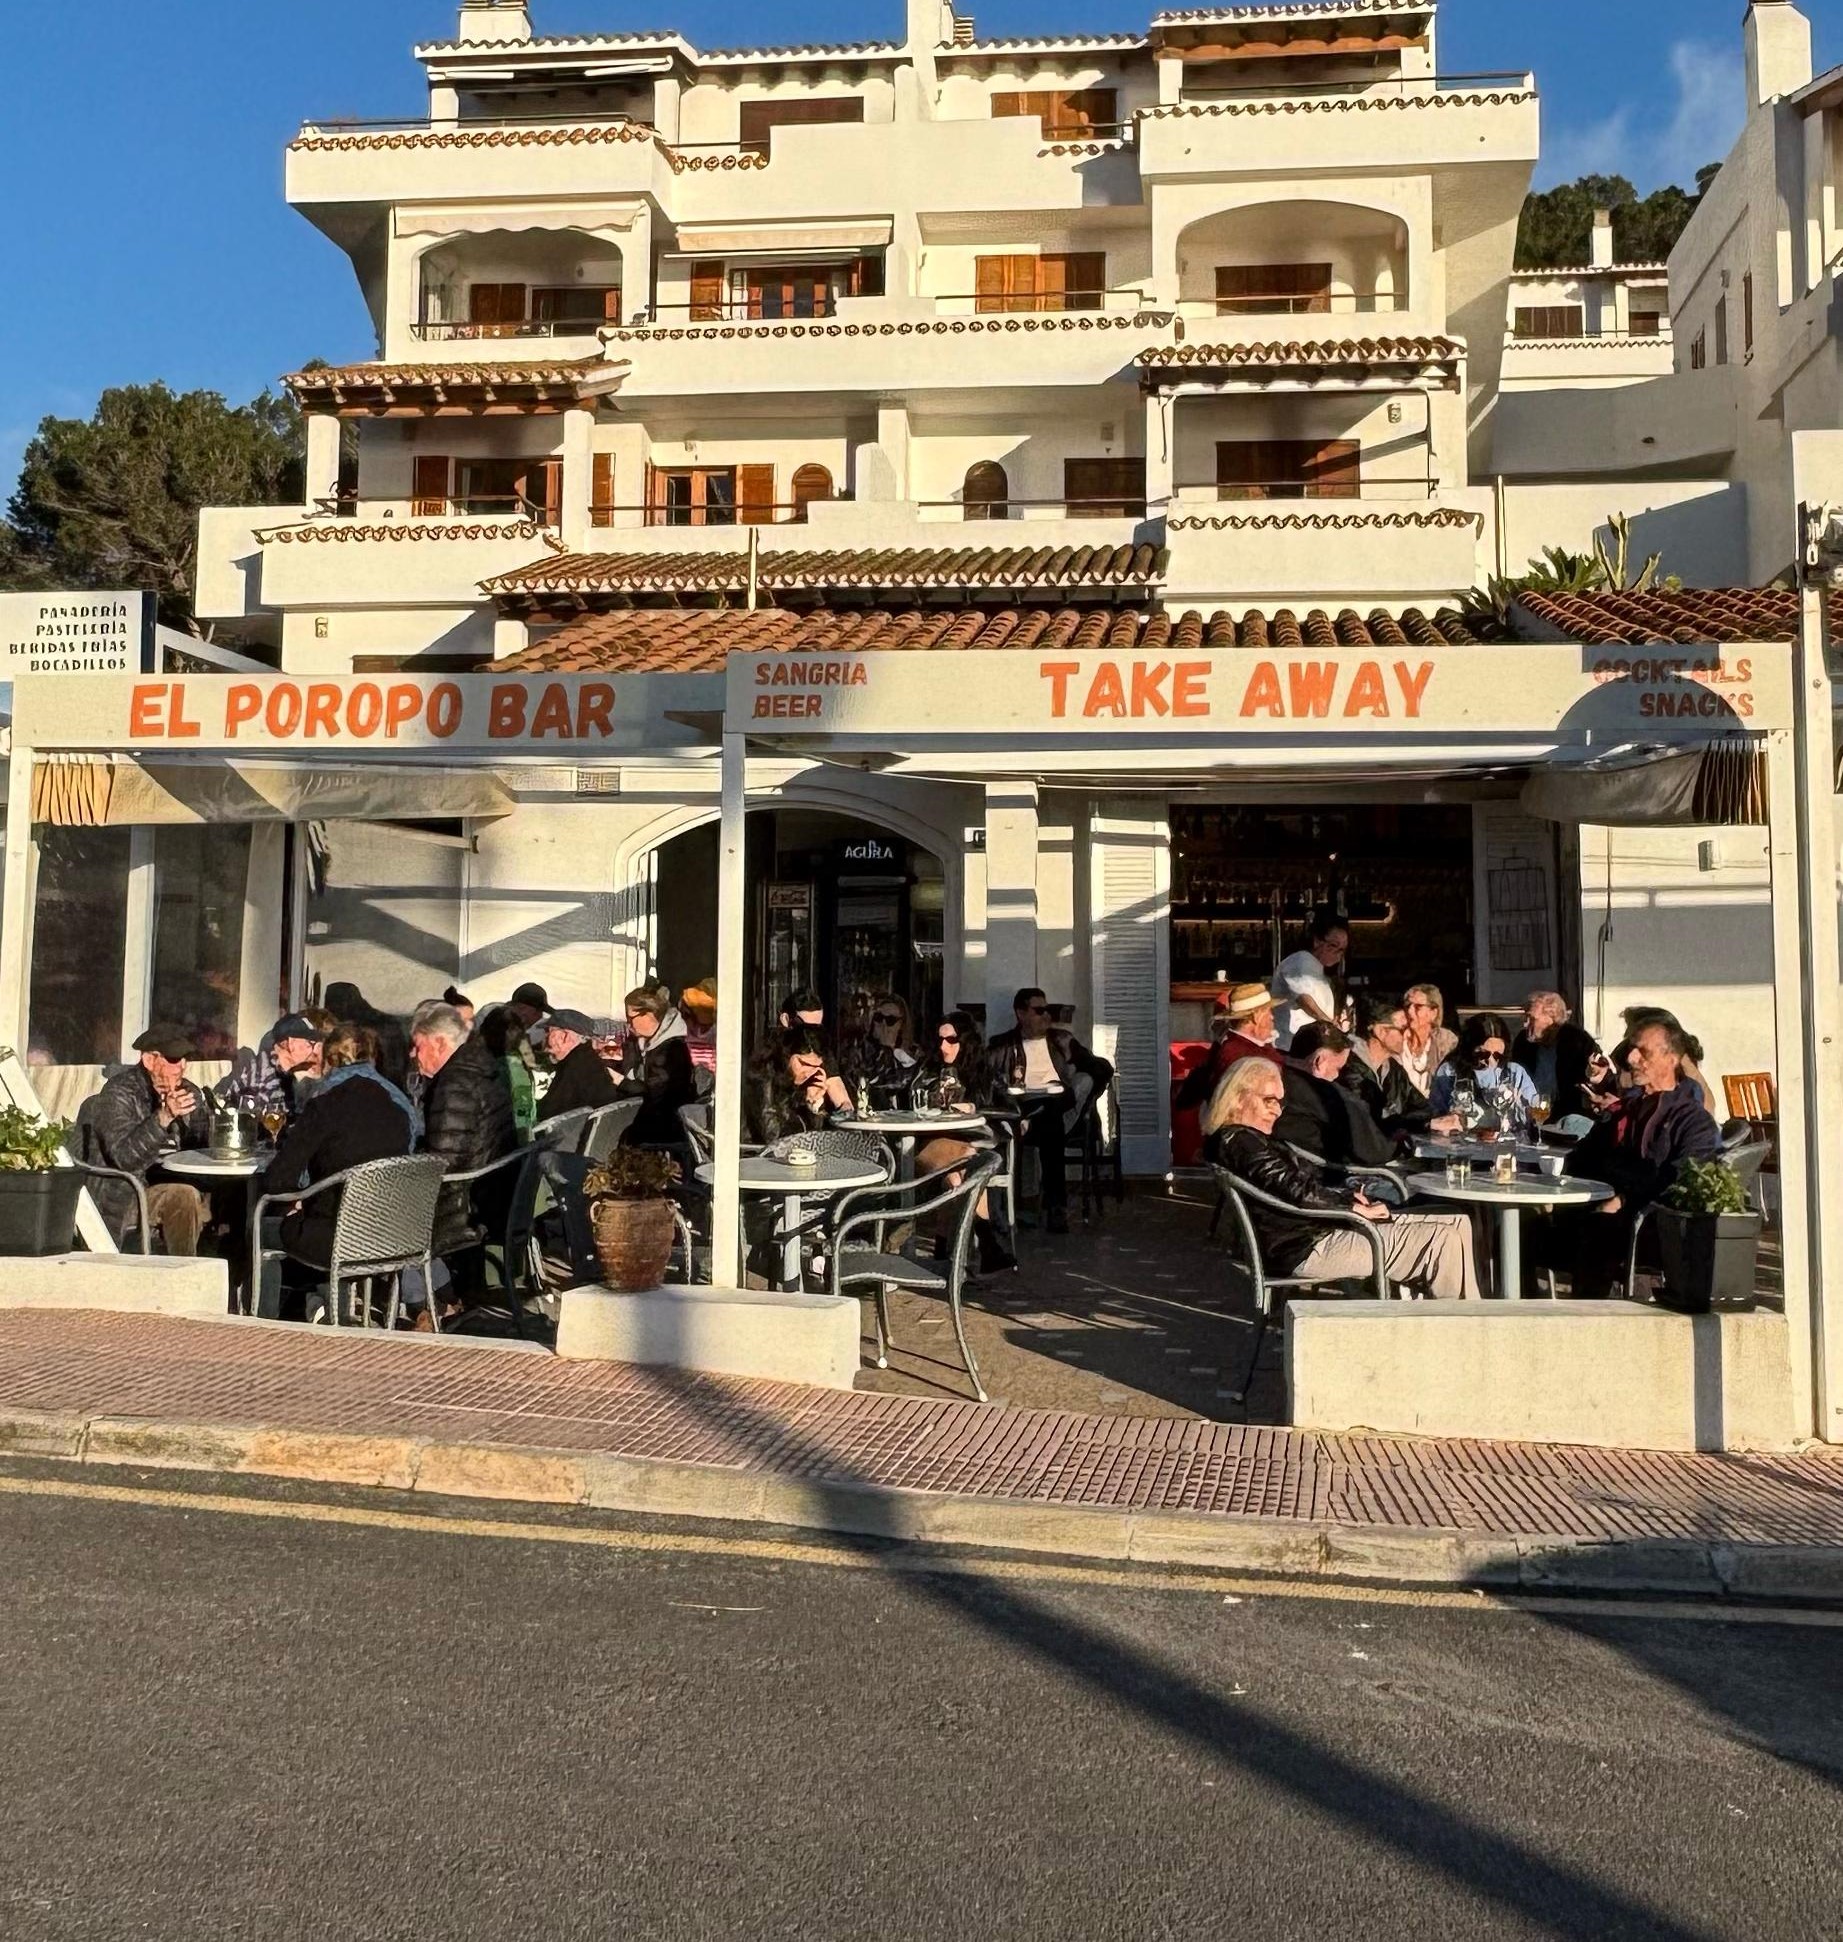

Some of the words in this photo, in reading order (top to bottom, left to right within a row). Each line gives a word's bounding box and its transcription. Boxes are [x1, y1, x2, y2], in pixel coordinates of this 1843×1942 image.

[9, 642, 75, 654] BEBIDAS
[30, 658, 126, 671] BOCADILLOS
[755, 661, 867, 686] SANGRIA
[1592, 657, 1752, 684] COCKTAILS
[1040, 661, 1212, 717] TAKE
[1239, 661, 1434, 717] AWAY
[129, 683, 201, 738] EL
[224, 682, 464, 739] POROPO
[487, 683, 616, 739] BAR
[752, 693, 822, 719] BEER
[1639, 692, 1754, 718] SNACKS
